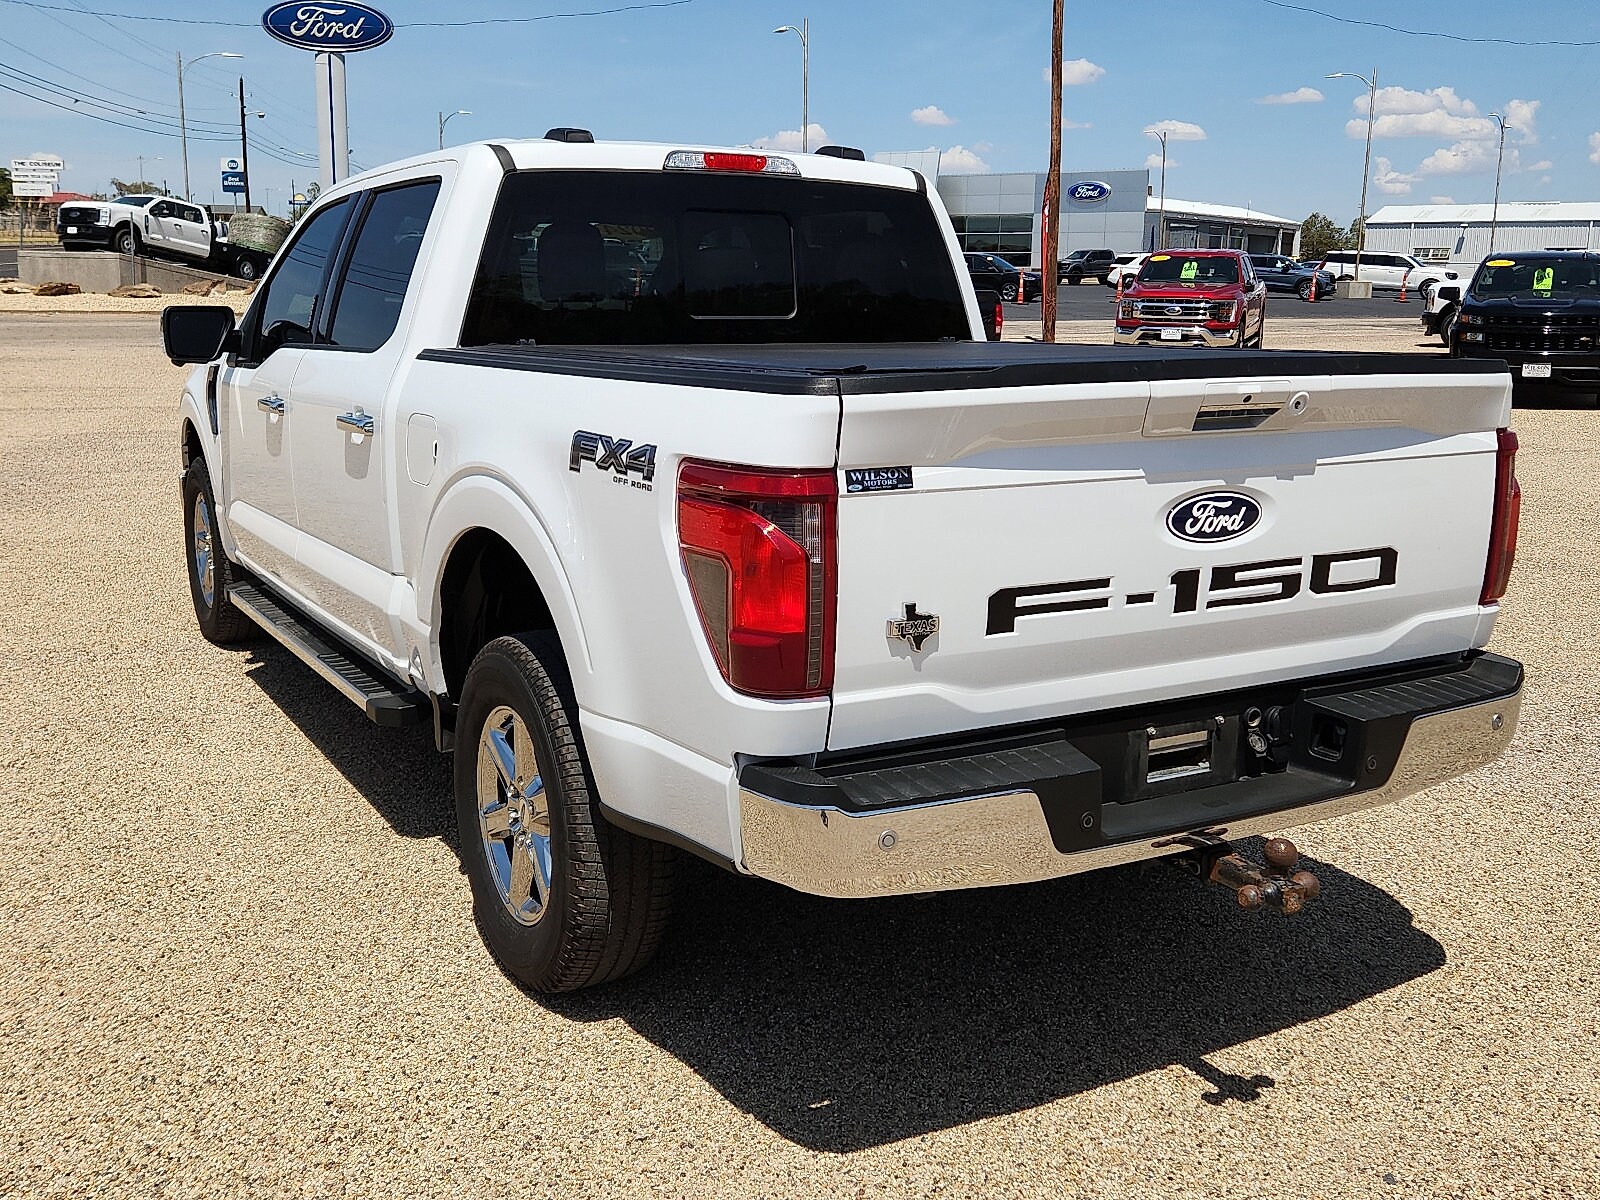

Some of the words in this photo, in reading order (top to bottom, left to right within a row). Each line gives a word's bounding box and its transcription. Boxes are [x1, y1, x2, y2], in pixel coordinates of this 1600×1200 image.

[290, 6, 366, 39] Ford
[1075, 185, 1101, 197] Ford
[569, 430, 657, 482] FX4
[612, 475, 628, 486] OFF
[631, 480, 653, 492] ROAD
[850, 469, 908, 481] WILSON
[863, 478, 898, 487] MOTORS
[1184, 500, 1247, 535] Ford
[985, 546, 1398, 636] F-150
[895, 619, 937, 633] TEXAS
